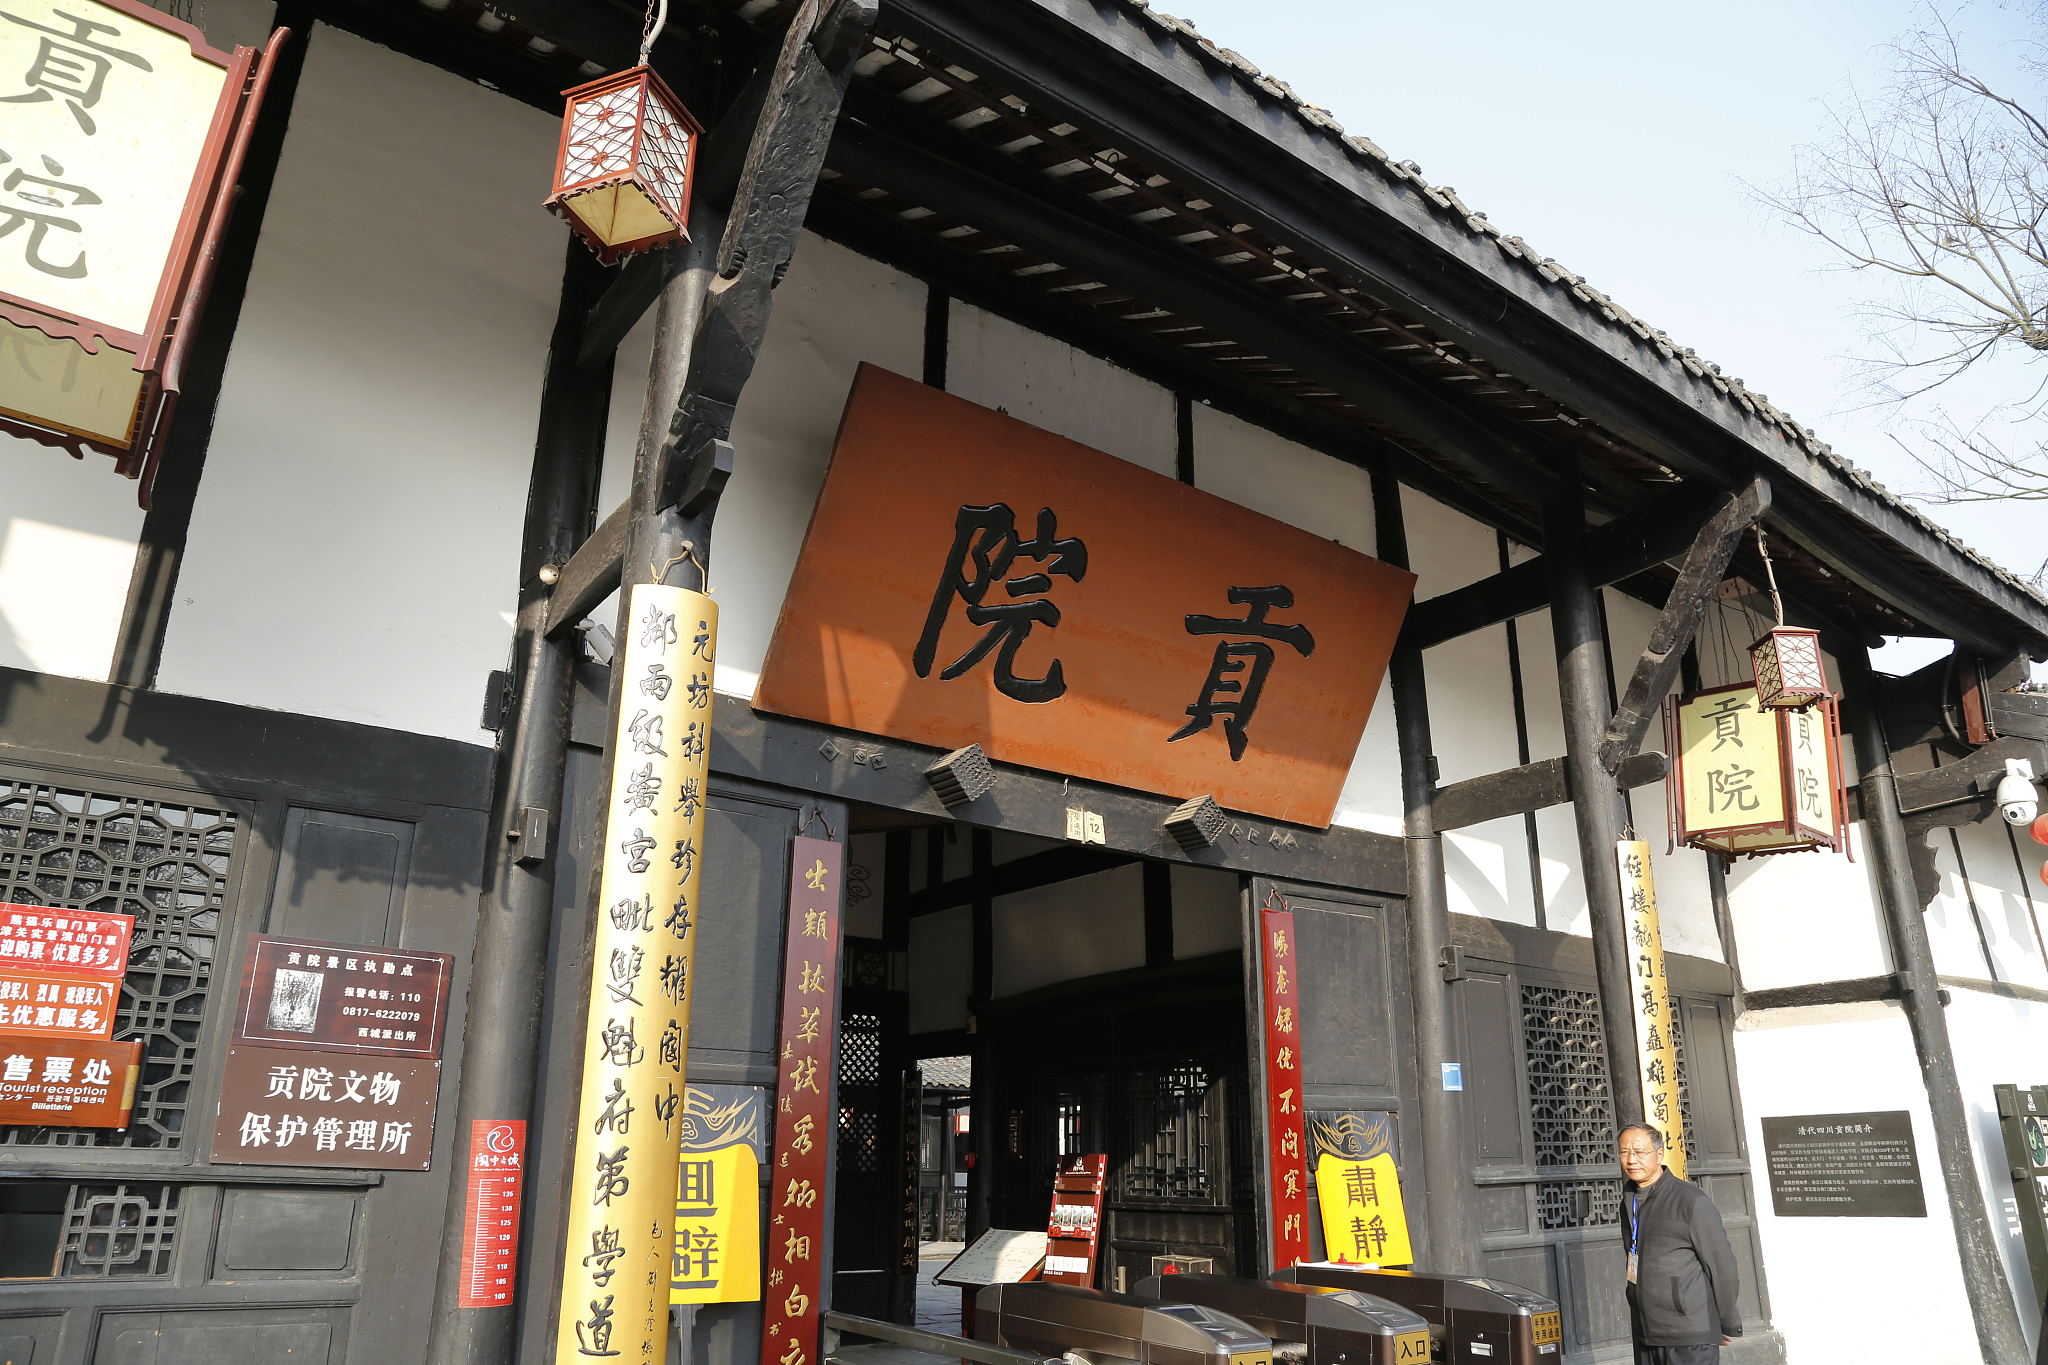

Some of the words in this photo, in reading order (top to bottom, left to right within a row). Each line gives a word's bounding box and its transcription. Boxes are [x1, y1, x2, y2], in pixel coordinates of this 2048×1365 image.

[1701, 697, 1760, 814] 貢院
[1089, 823, 1100, 834] 12
[10, 914, 99, 933] 熊猫乐园门票
[51, 943, 110, 965] 优惠多多
[286, 951, 415, 977] 贡院景区执勤点
[0, 980, 30, 1001] 役军人
[64, 986, 103, 1006] 现役军人
[342, 1006, 421, 1022] 0817-6222079
[357, 1026, 417, 1042] 西城派出所
[3, 1053, 113, 1086] 售票处
[42, 1085, 108, 1097] reception
[264, 1064, 401, 1106] 贡院文物
[31, 1102, 73, 1112] Billetterie
[239, 1111, 414, 1155] 保护管理所
[1341, 1164, 1388, 1261] 肅靜
[498, 1248, 509, 1256] 115
[494, 1292, 506, 1300] 100
[1400, 1339, 1426, 1360] 入口
